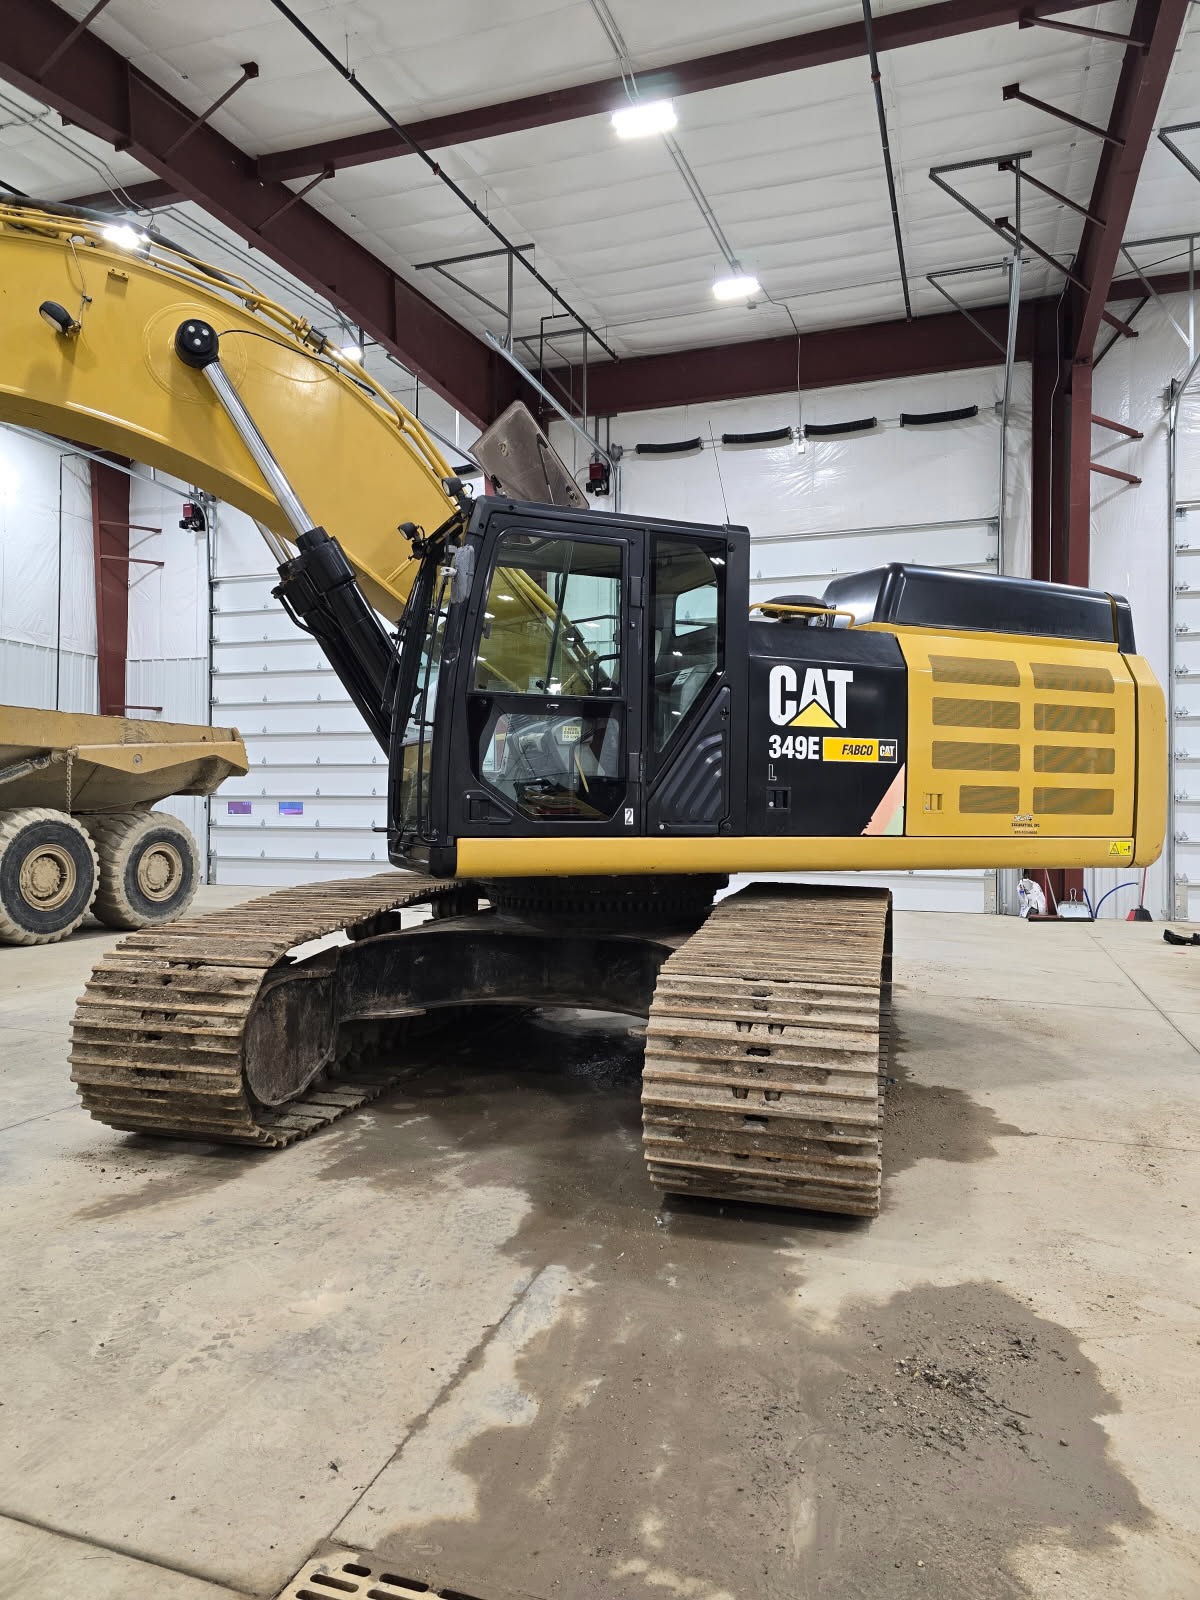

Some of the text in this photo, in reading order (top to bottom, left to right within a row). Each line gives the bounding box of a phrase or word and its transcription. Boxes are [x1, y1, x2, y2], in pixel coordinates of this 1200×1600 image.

[769, 664, 854, 729] CAT
[768, 734, 820, 760] 349E
[842, 744, 895, 757] FABCO CAT
[768, 763, 777, 781] L
[626, 808, 633, 824] 2
